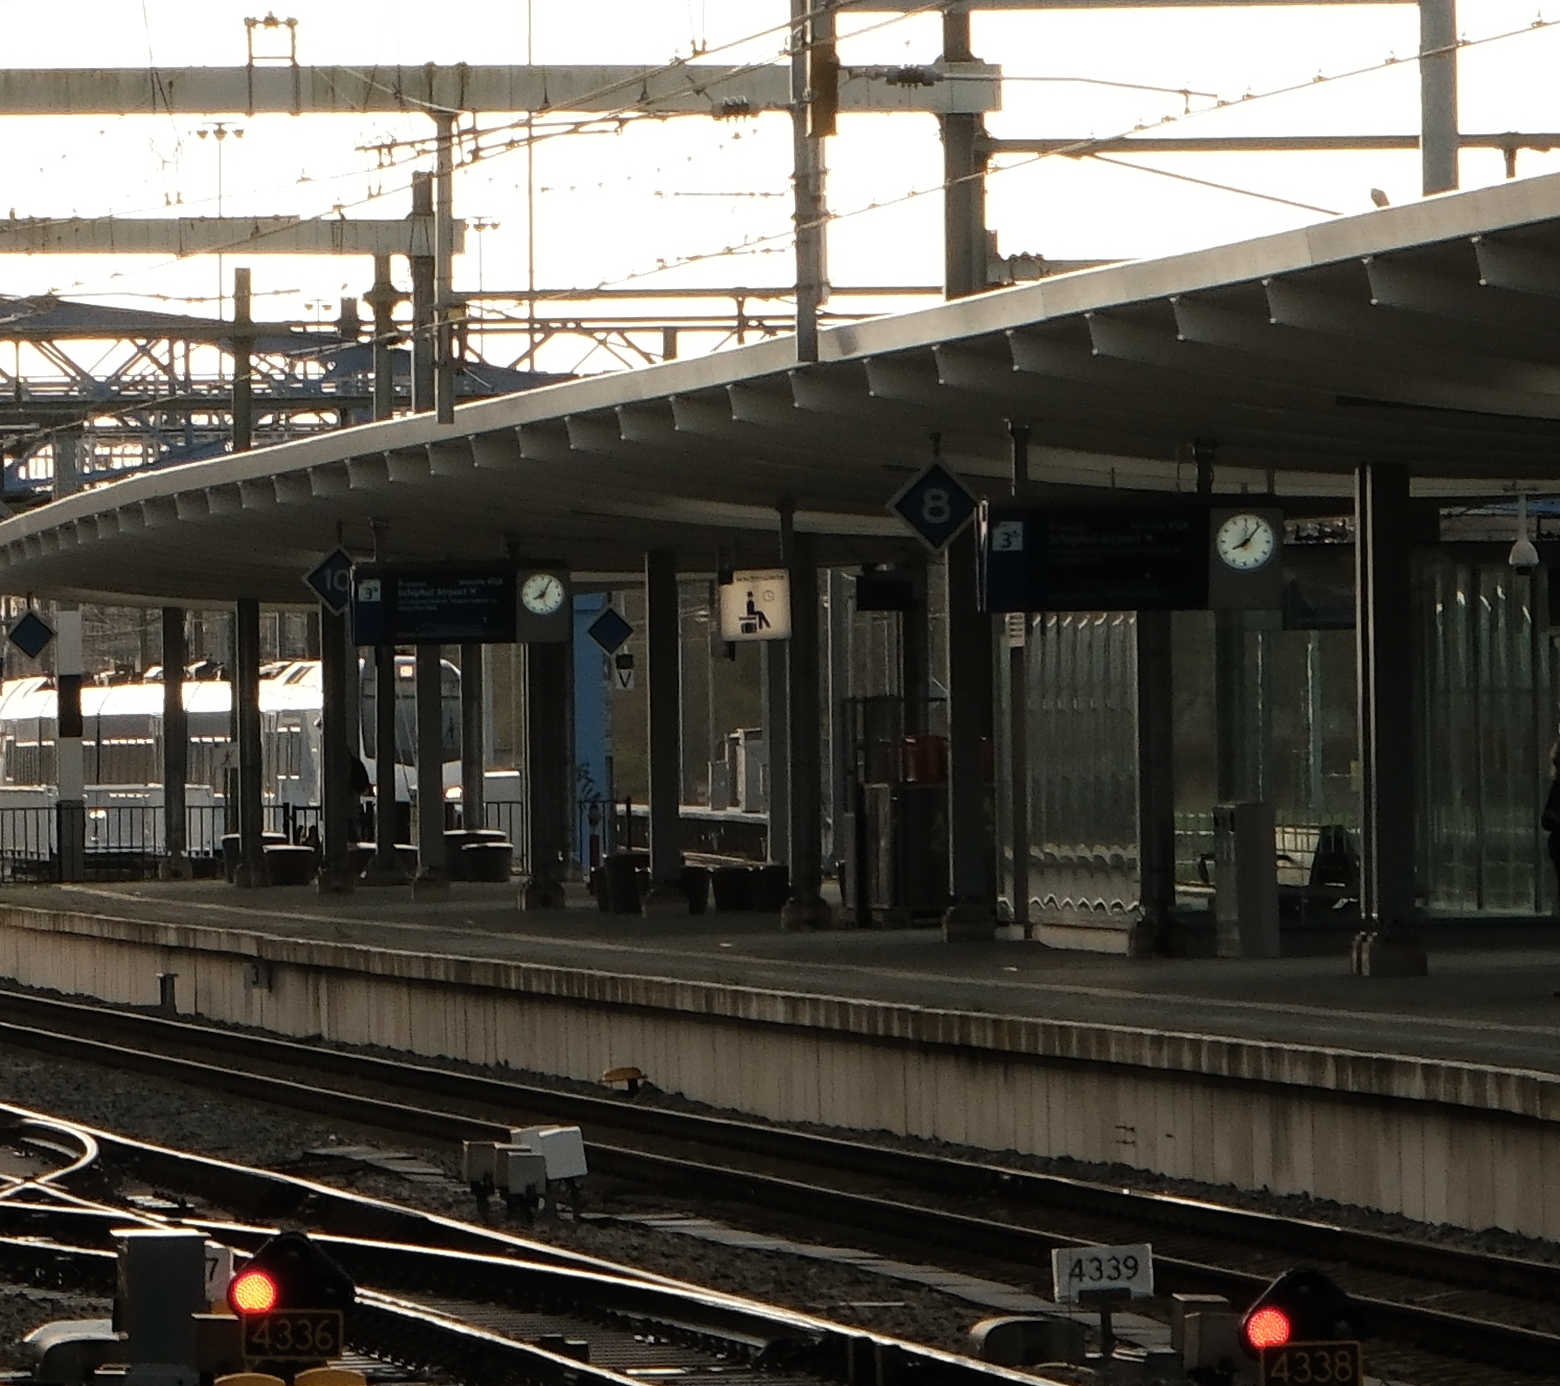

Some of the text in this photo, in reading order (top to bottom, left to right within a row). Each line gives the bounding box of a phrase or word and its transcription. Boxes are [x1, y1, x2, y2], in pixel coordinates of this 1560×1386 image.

[921, 488, 951, 524] 8
[1069, 1254, 1139, 1283] 4339
[252, 1316, 334, 1356] 4336
[1269, 1349, 1354, 1384] 4338
